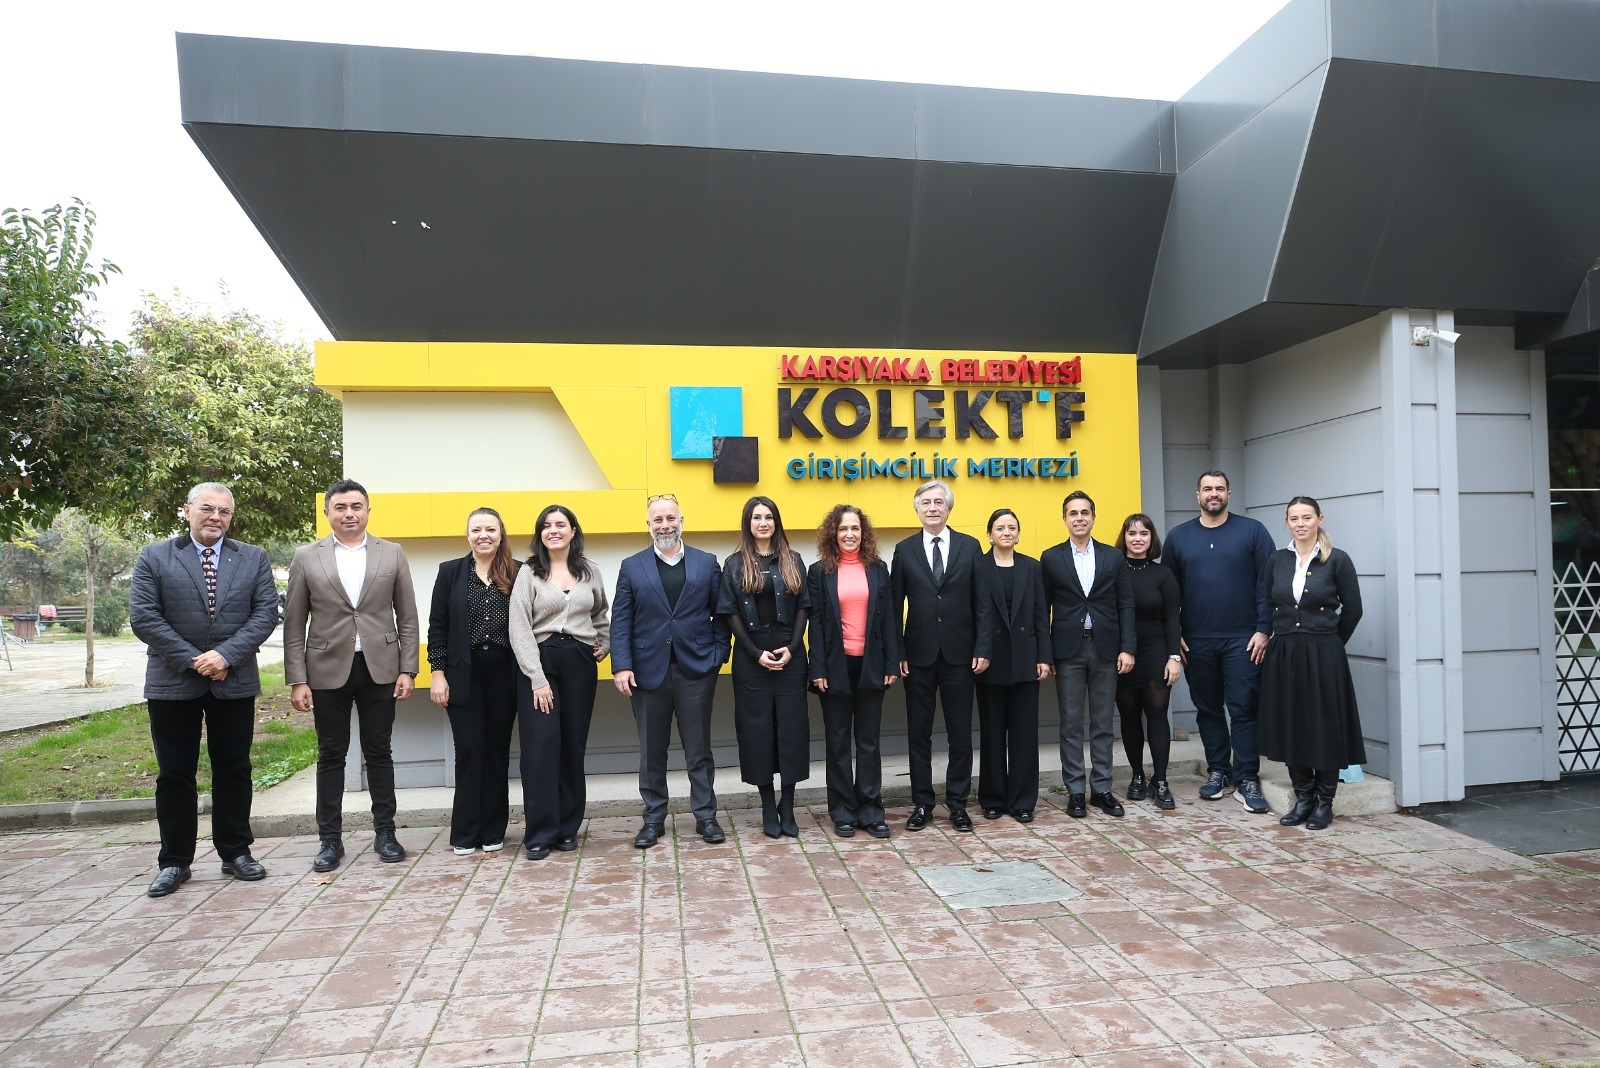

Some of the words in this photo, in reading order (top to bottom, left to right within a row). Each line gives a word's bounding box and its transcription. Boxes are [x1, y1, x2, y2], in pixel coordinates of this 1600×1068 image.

[781, 354, 933, 382] KARŞIYAKA
[940, 354, 1082, 385] BELEDİYESİ
[777, 386, 1086, 440] KOLEKTF
[786, 451, 959, 482] GİRİŞİMCİLİK
[967, 450, 1079, 478] MERKEZİ
